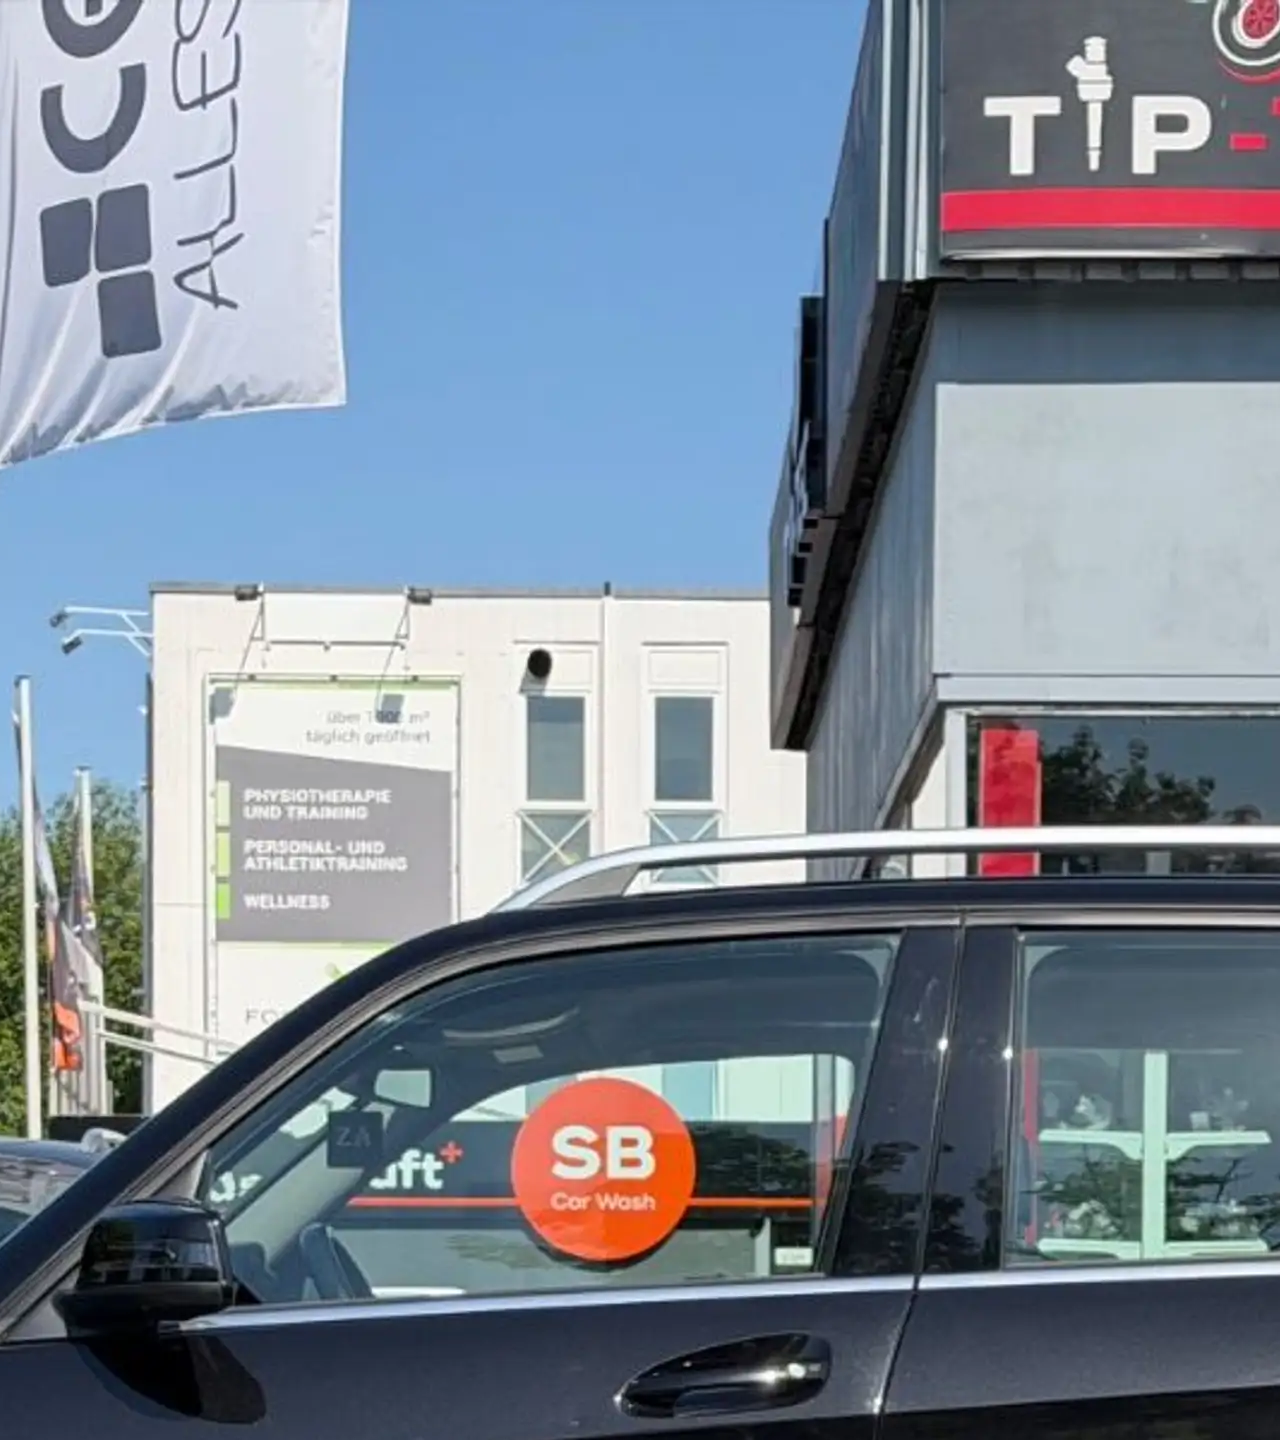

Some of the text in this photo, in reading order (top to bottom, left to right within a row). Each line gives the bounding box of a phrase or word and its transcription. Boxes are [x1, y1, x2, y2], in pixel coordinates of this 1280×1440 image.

[172, 0, 245, 310] ALLES
[327, 711, 361, 724] über
[305, 730, 430, 745] täglich geöffnet
[243, 788, 393, 804] PHYSIOTHERAPIE
[243, 805, 369, 820] UND TRAINING
[243, 840, 386, 855] PERSONAL- UND
[243, 856, 408, 872] ATHLETIKTRAINING
[243, 894, 330, 911] WELLNESS
[551, 1125, 656, 1180] SB
[550, 1191, 656, 1211] Car Wash
